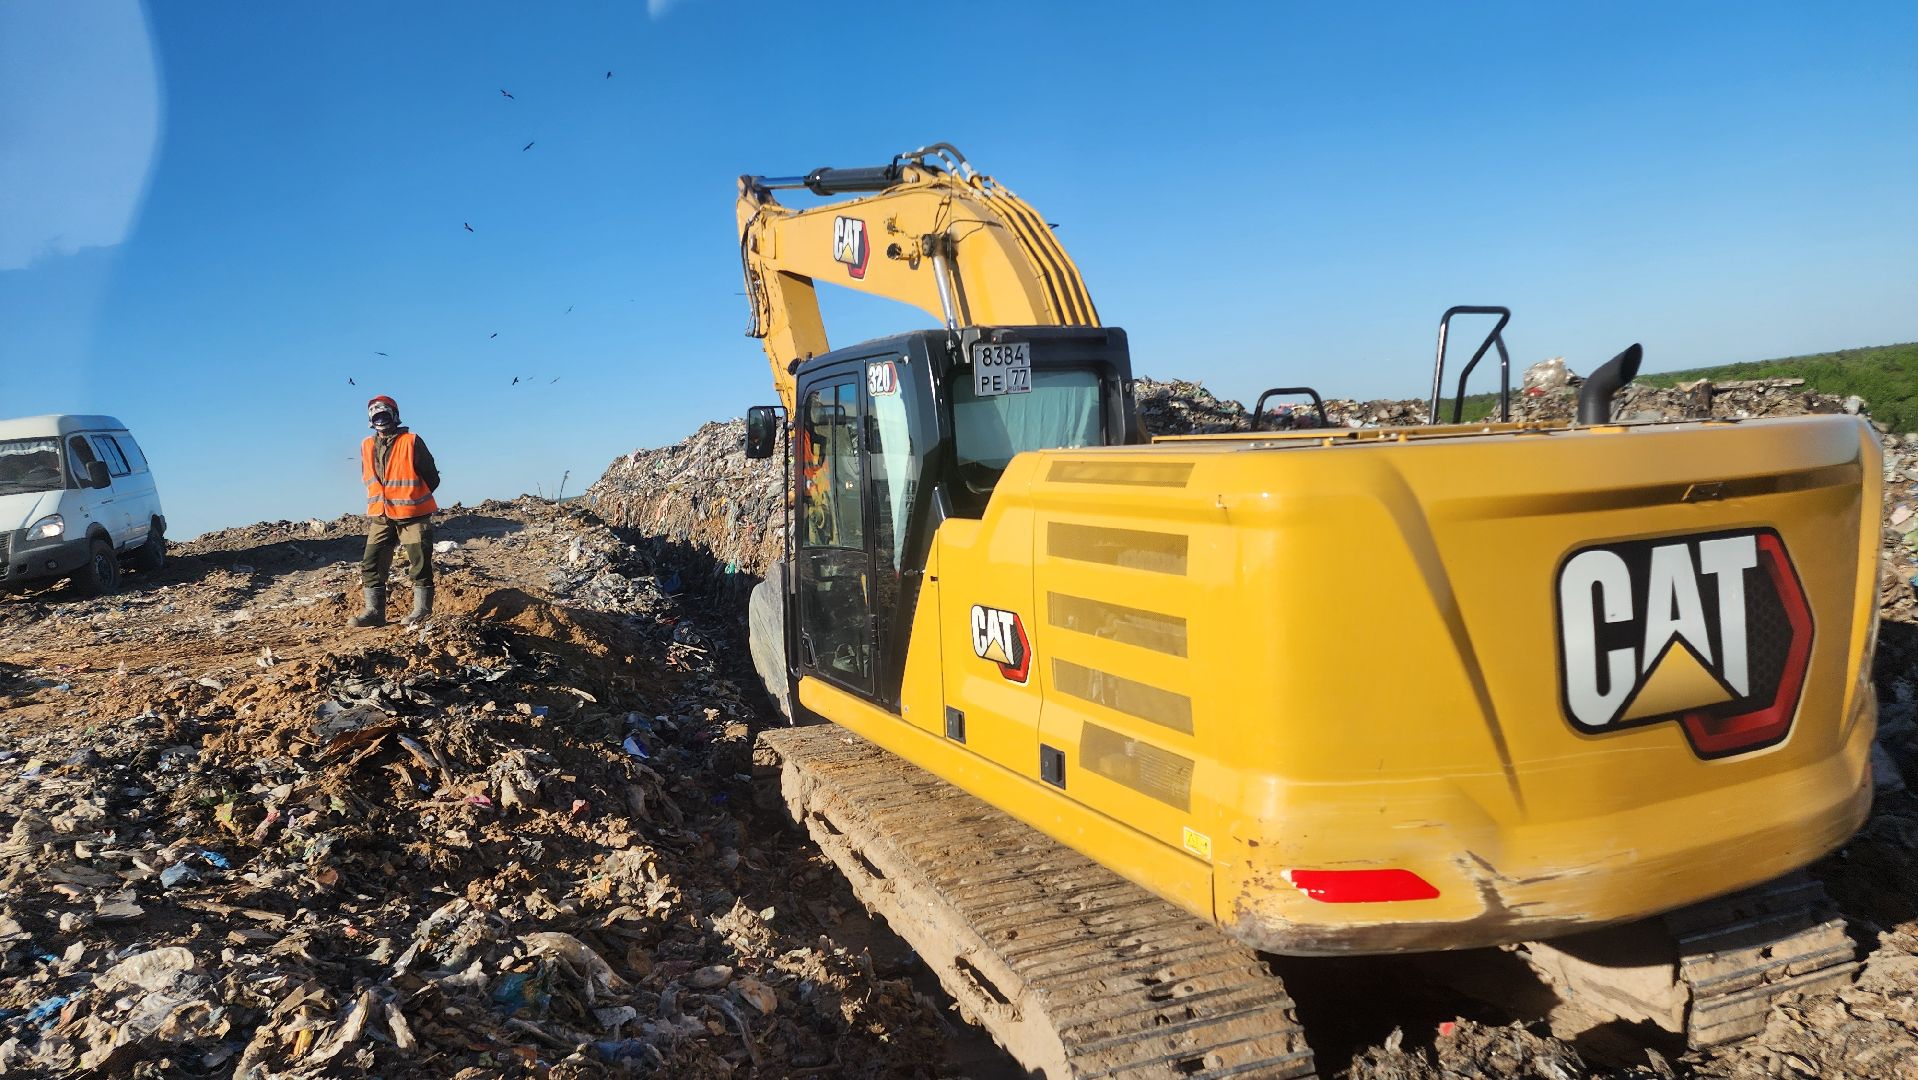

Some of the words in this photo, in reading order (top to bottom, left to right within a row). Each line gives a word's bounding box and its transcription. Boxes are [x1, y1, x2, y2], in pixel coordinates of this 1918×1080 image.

[834, 216, 863, 264] CAT
[982, 345, 1024, 366] 8384
[869, 363, 890, 394] 320
[1011, 369, 1027, 385] 77
[971, 605, 1014, 665] CAT
[1560, 535, 1757, 726] CAT
